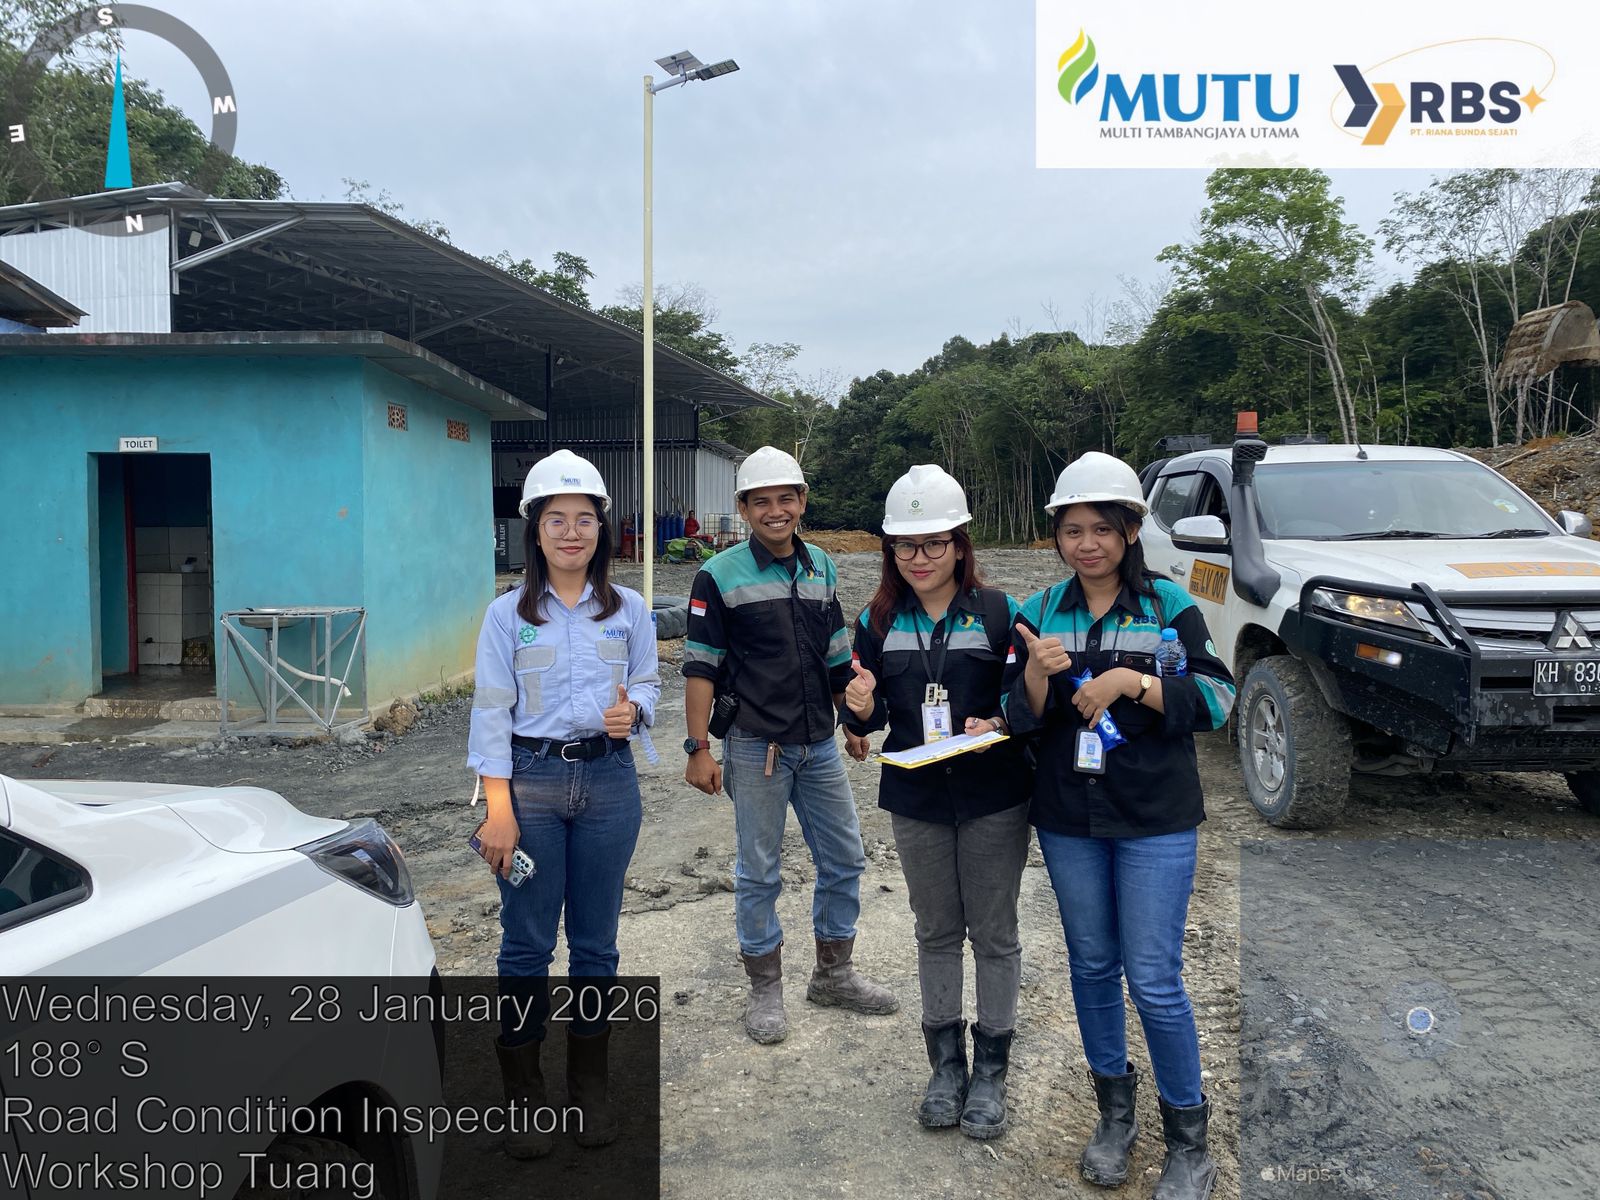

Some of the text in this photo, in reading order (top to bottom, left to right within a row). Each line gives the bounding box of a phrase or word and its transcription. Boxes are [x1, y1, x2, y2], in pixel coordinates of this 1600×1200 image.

[124, 440, 153, 449] TOILET
[1133, 614, 1158, 625] RBS
[1537, 662, 1559, 683] KH
